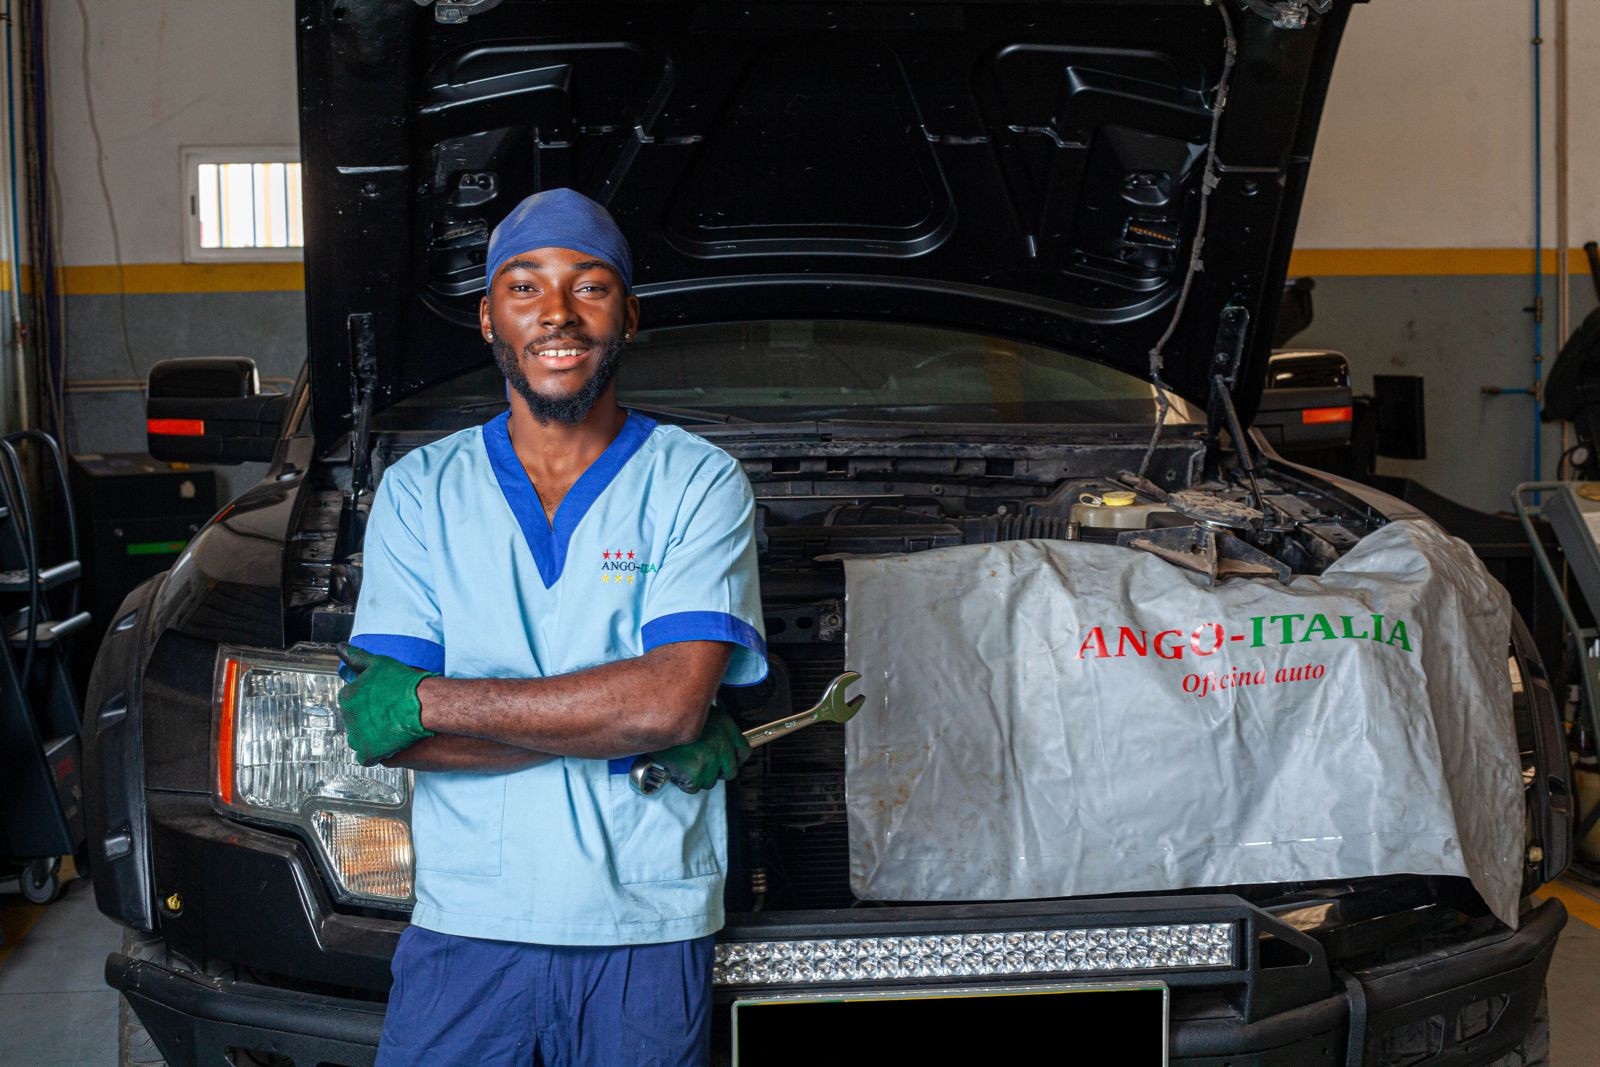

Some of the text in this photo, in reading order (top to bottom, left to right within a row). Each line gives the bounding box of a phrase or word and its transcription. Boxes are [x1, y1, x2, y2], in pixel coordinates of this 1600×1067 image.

[1076, 613, 1413, 660] ANGO-ITALIA
[1182, 662, 1325, 698] Oficina auto
